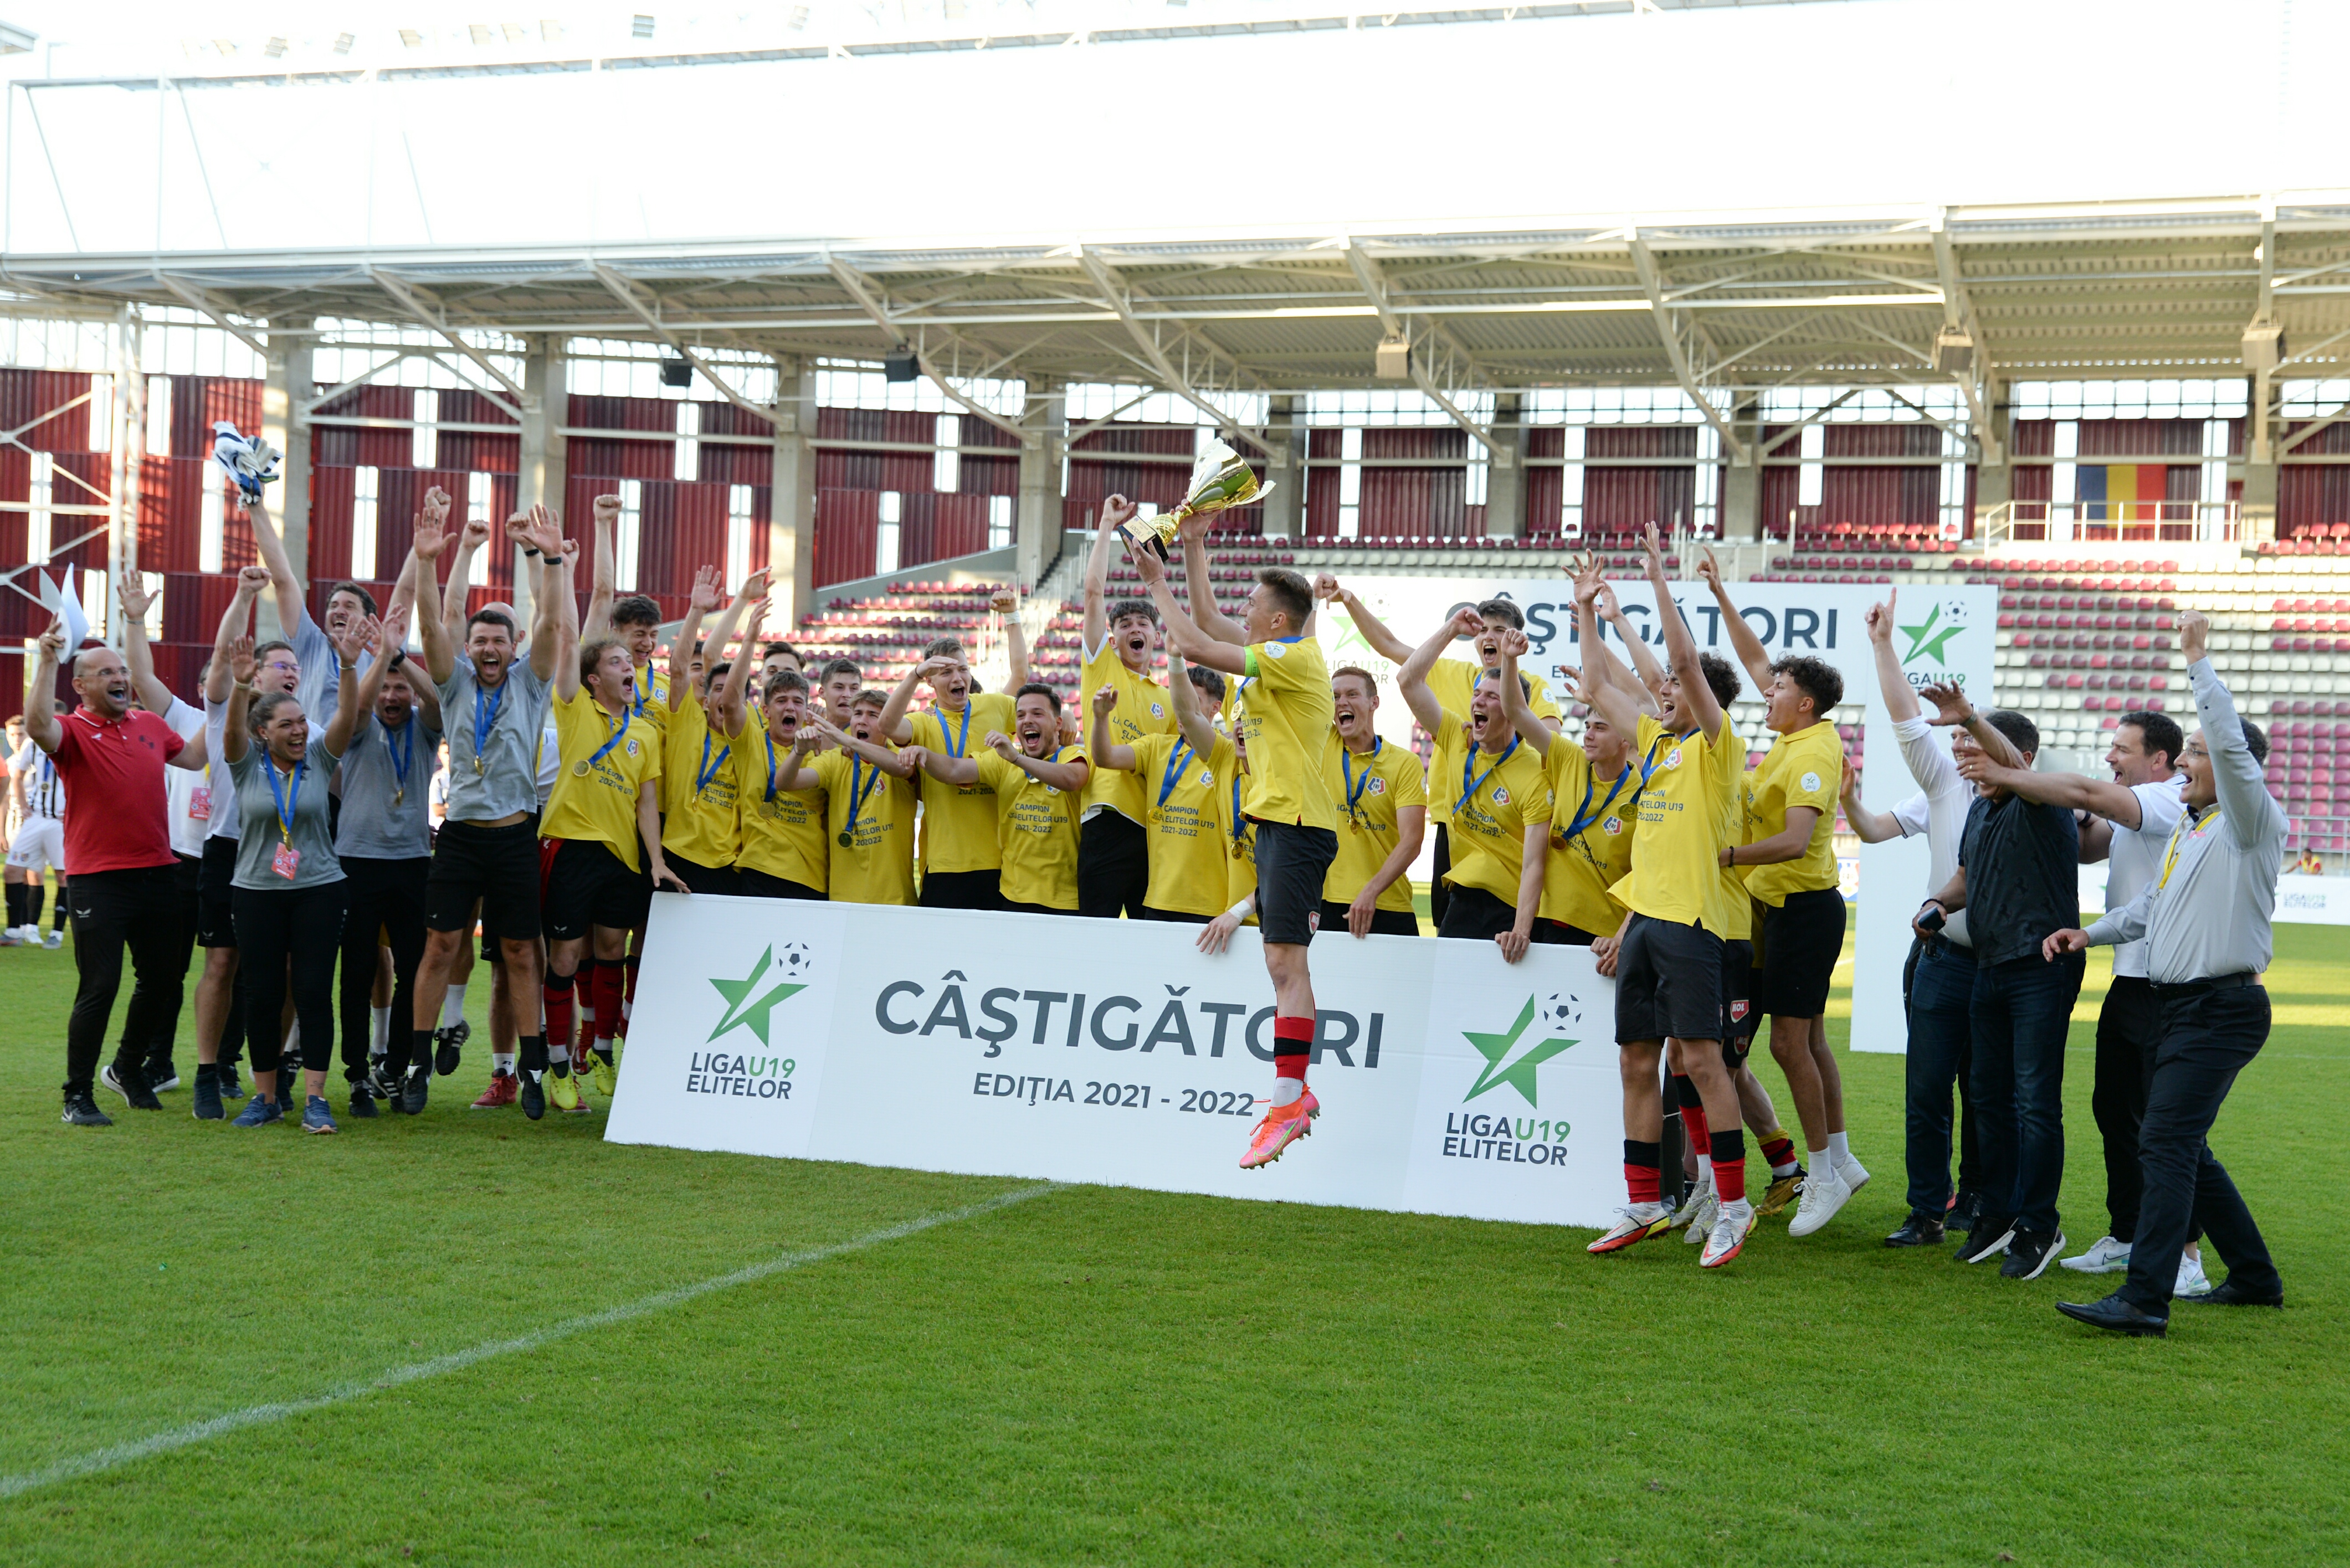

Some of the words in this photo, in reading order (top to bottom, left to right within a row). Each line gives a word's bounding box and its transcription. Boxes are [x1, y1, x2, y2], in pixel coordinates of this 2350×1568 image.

[1015, 803, 1050, 813] CAMPION
[1164, 805, 1199, 815] CAMPION
[1668, 803, 1684, 811] U19
[1017, 814, 1052, 823] ELITELOR
[1165, 815, 1199, 826] ELITELOR
[1200, 820, 1215, 829] U19
[1015, 823, 1051, 833] 2021-2022
[1161, 825, 1198, 837] 2021-2022
[1553, 824, 1566, 832] LIG
[1732, 1003, 1744, 1012] MOL
[686, 1074, 792, 1099] ELITELOR
[1084, 1081, 1151, 1108] 2021
[1179, 1089, 1254, 1117] 2022
[1443, 1137, 1567, 1166] ELITELOR
